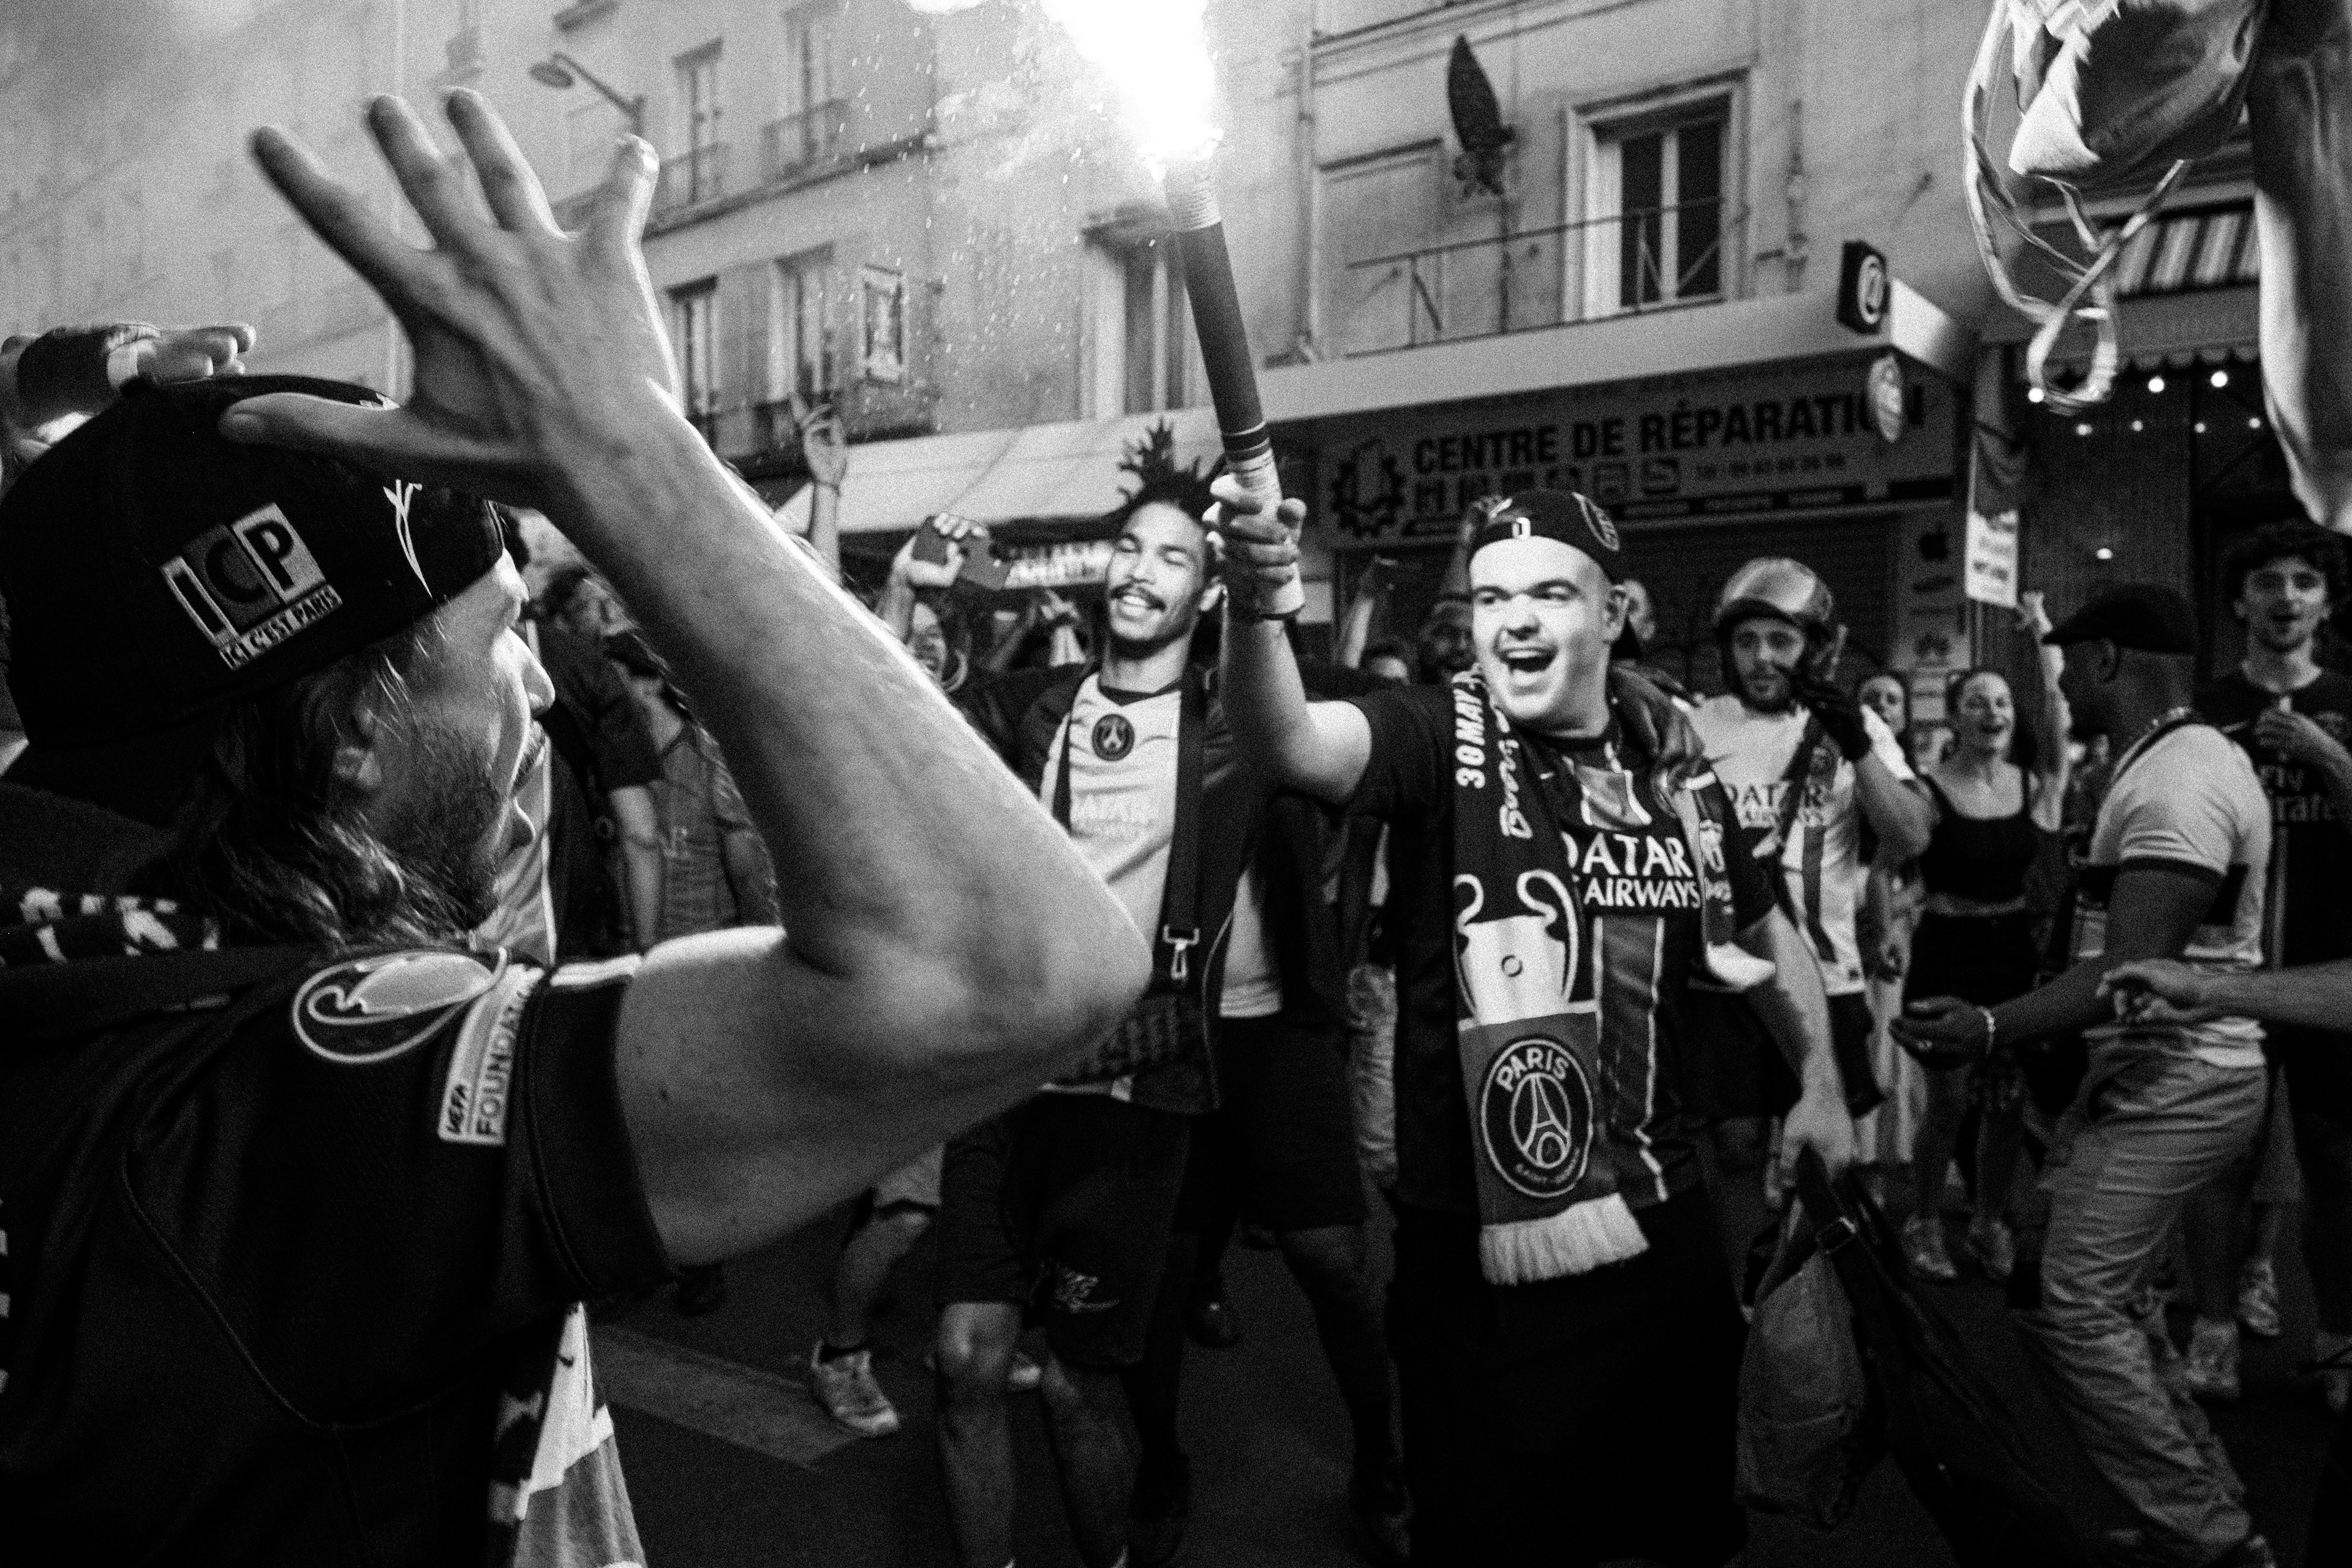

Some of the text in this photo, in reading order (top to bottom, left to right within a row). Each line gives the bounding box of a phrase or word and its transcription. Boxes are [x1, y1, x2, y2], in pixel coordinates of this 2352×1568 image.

[1414, 385, 1926, 475] CENTRE DE RÉPARATIN
[172, 519, 295, 634] ICP
[291, 586, 341, 627] PARIS
[1583, 876, 1702, 910] AIRWAYS
[1496, 1047, 1570, 1092] PARIS
[445, 1083, 469, 1134] UEFA
